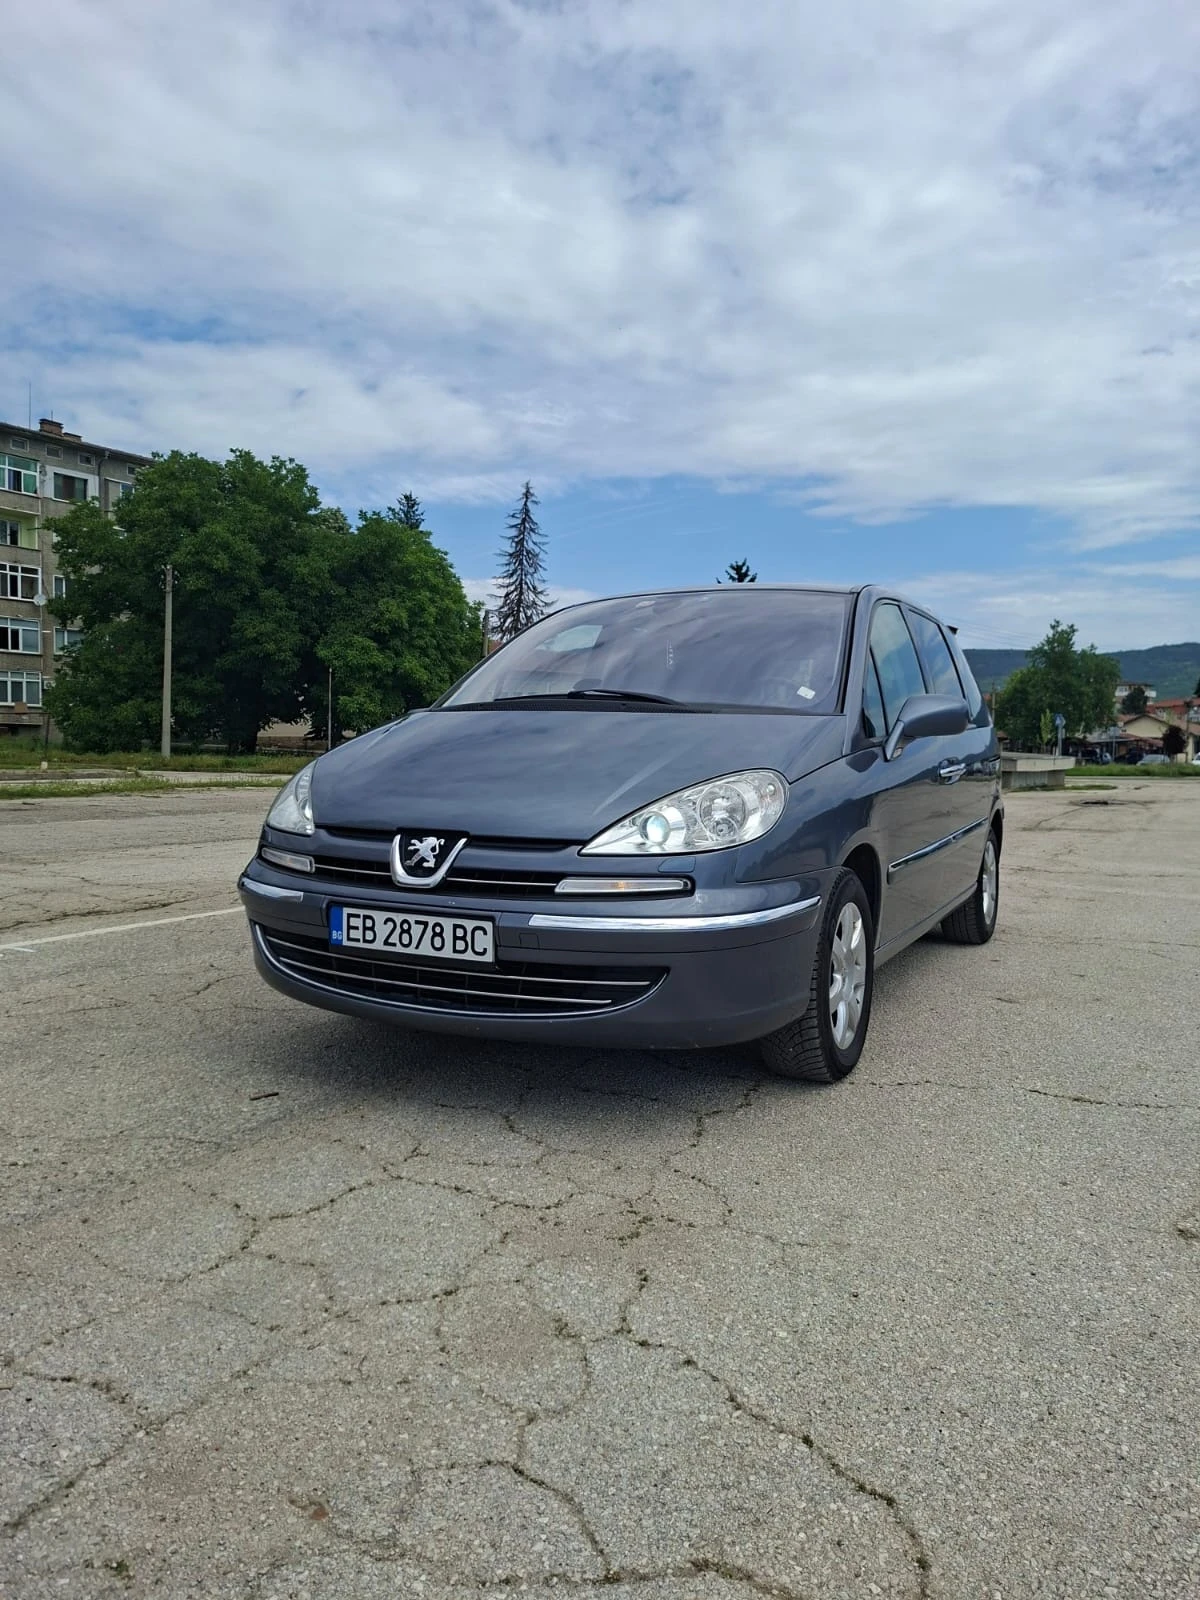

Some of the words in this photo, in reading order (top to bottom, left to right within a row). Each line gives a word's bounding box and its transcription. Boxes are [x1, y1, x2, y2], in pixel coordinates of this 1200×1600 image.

[332, 930, 342, 940] BG
[346, 913, 377, 944] EB
[383, 917, 446, 951] 2878
[452, 923, 488, 956] BC
